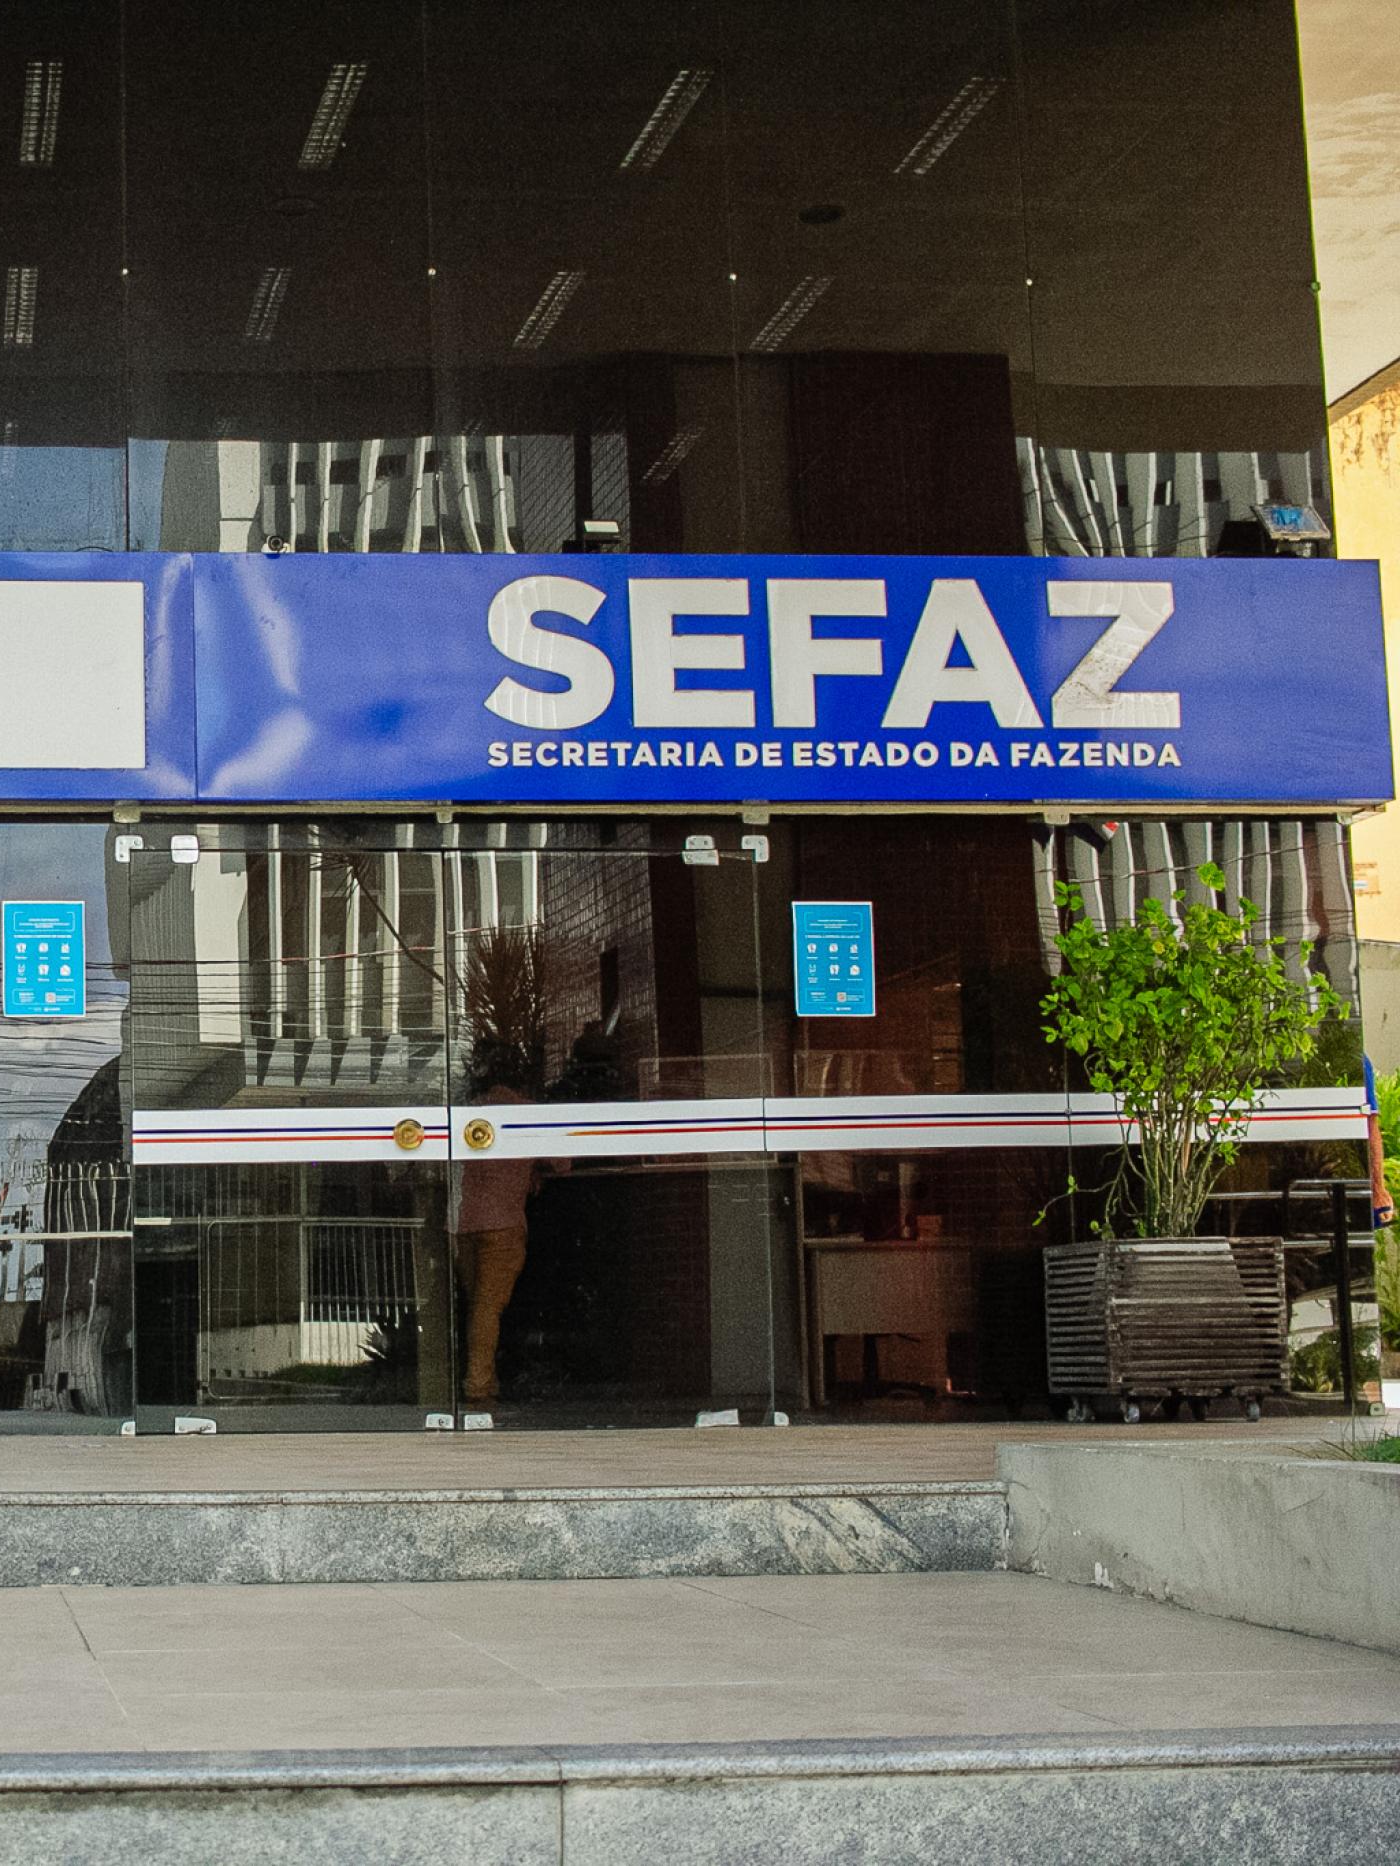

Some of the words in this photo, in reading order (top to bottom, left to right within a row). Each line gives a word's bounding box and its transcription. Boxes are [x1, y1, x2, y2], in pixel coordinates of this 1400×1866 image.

[484, 575, 1182, 730] SEFAZ
[487, 740, 724, 768] SECRETARIA
[735, 741, 783, 767] DE
[792, 741, 939, 768] ESTADO
[950, 741, 1000, 767] DA
[1011, 741, 1183, 768] FAZENDA
